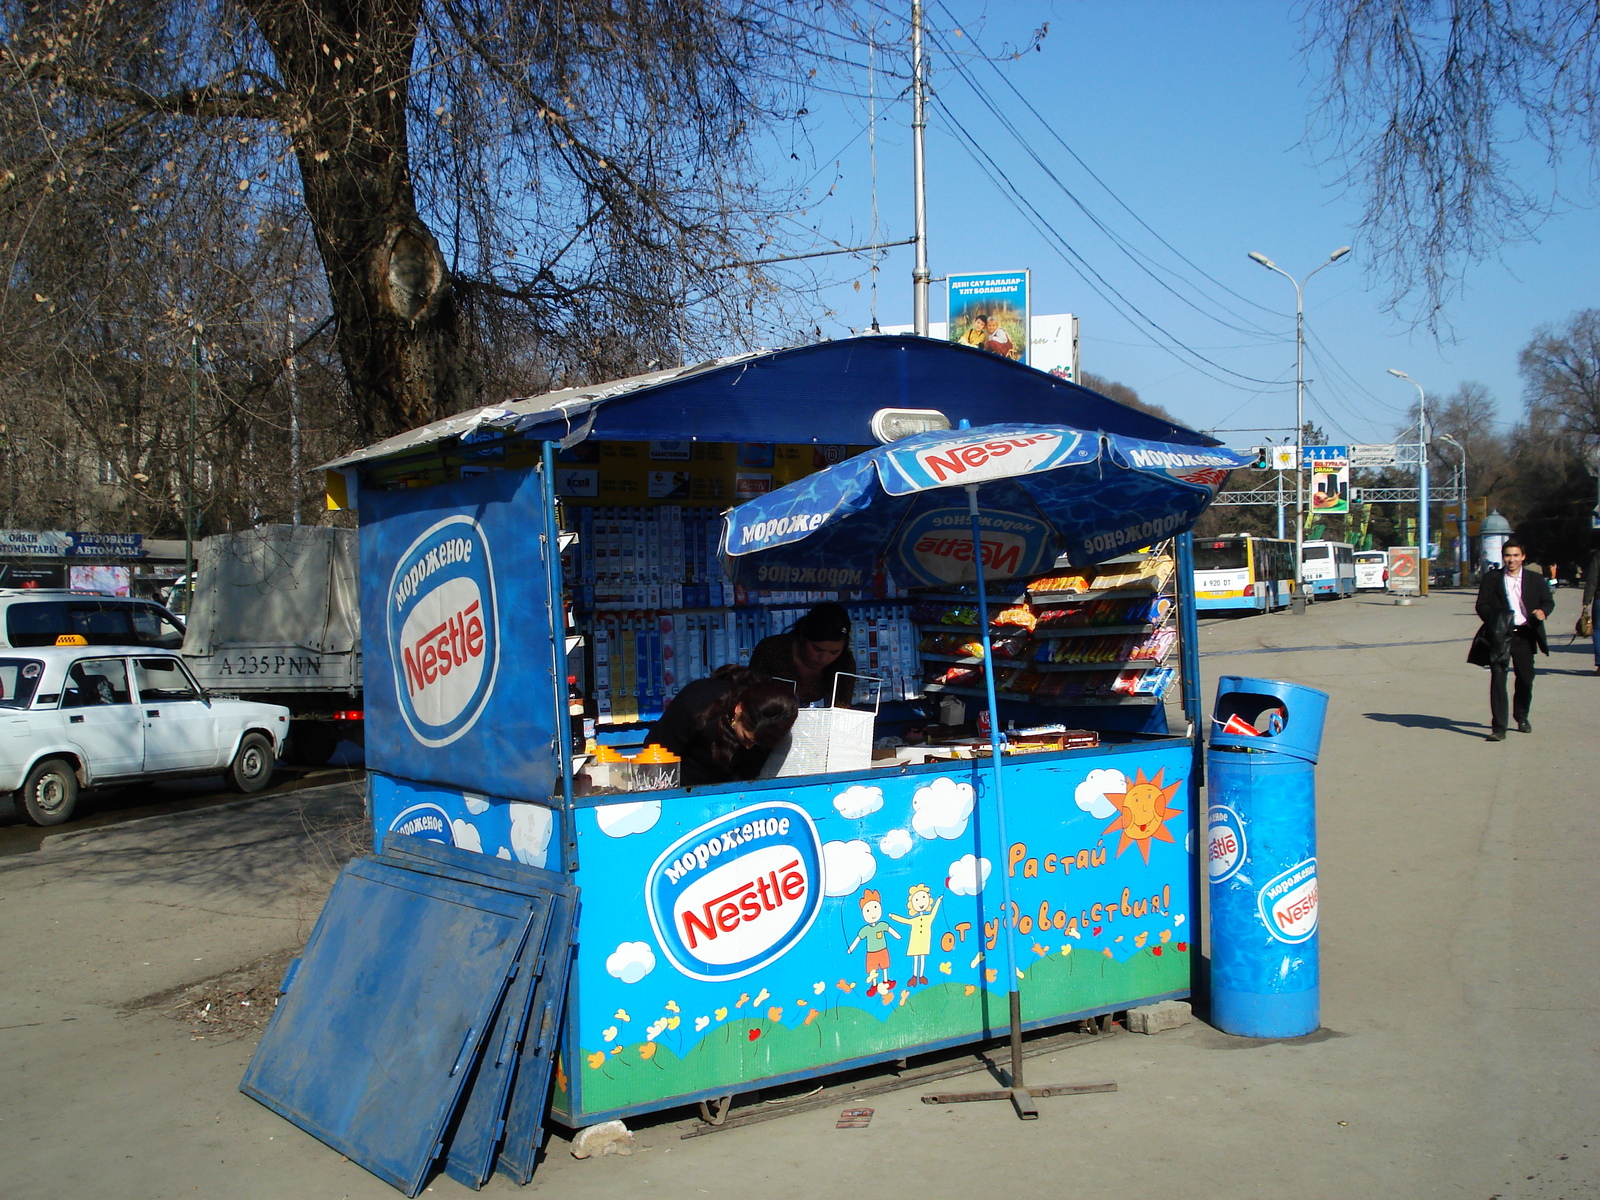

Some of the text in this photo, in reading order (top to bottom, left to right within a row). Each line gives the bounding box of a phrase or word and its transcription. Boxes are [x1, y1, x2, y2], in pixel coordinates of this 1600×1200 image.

[970, 280, 985, 288] САУ
[1130, 449, 1239, 469] мороженое
[741, 512, 830, 546] мороже
[394, 537, 473, 613] мороженое
[1209, 579, 1221, 587] 920
[397, 815, 443, 836] ороженое
[664, 817, 790, 885] мороженое
[1208, 833, 1237, 863] estlé
[681, 859, 805, 949] Nestlé
